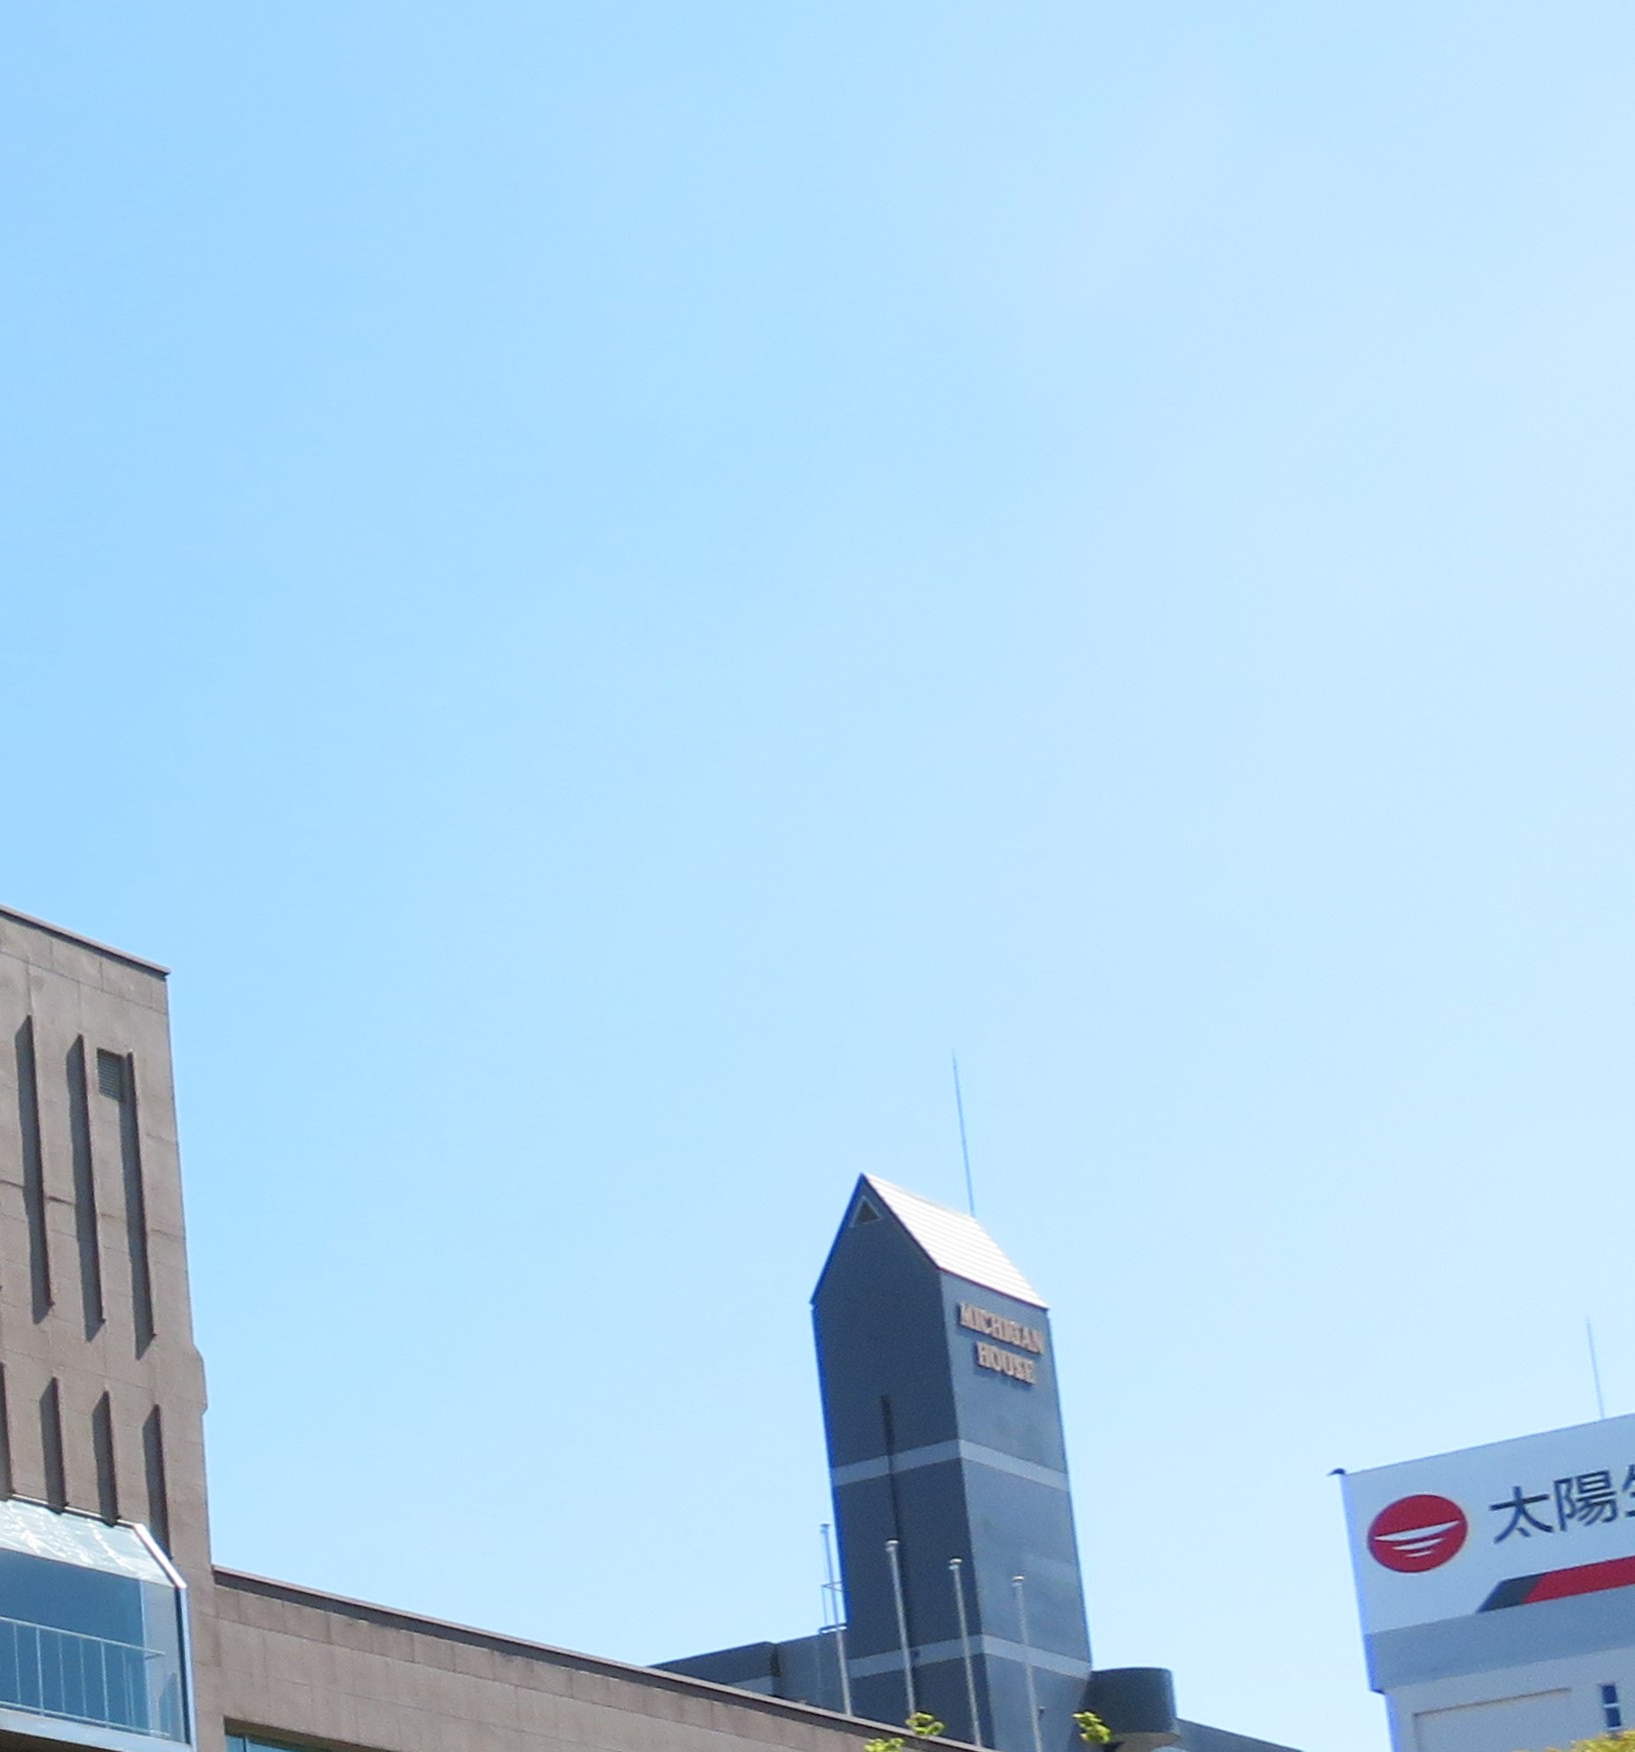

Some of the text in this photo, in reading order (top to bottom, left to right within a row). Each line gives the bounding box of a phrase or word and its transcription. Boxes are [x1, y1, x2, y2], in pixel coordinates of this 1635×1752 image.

[958, 1302, 1044, 1355] MICHIGAN
[976, 1341, 1035, 1385] HOUSE
[1490, 1464, 1635, 1544] 太陽
